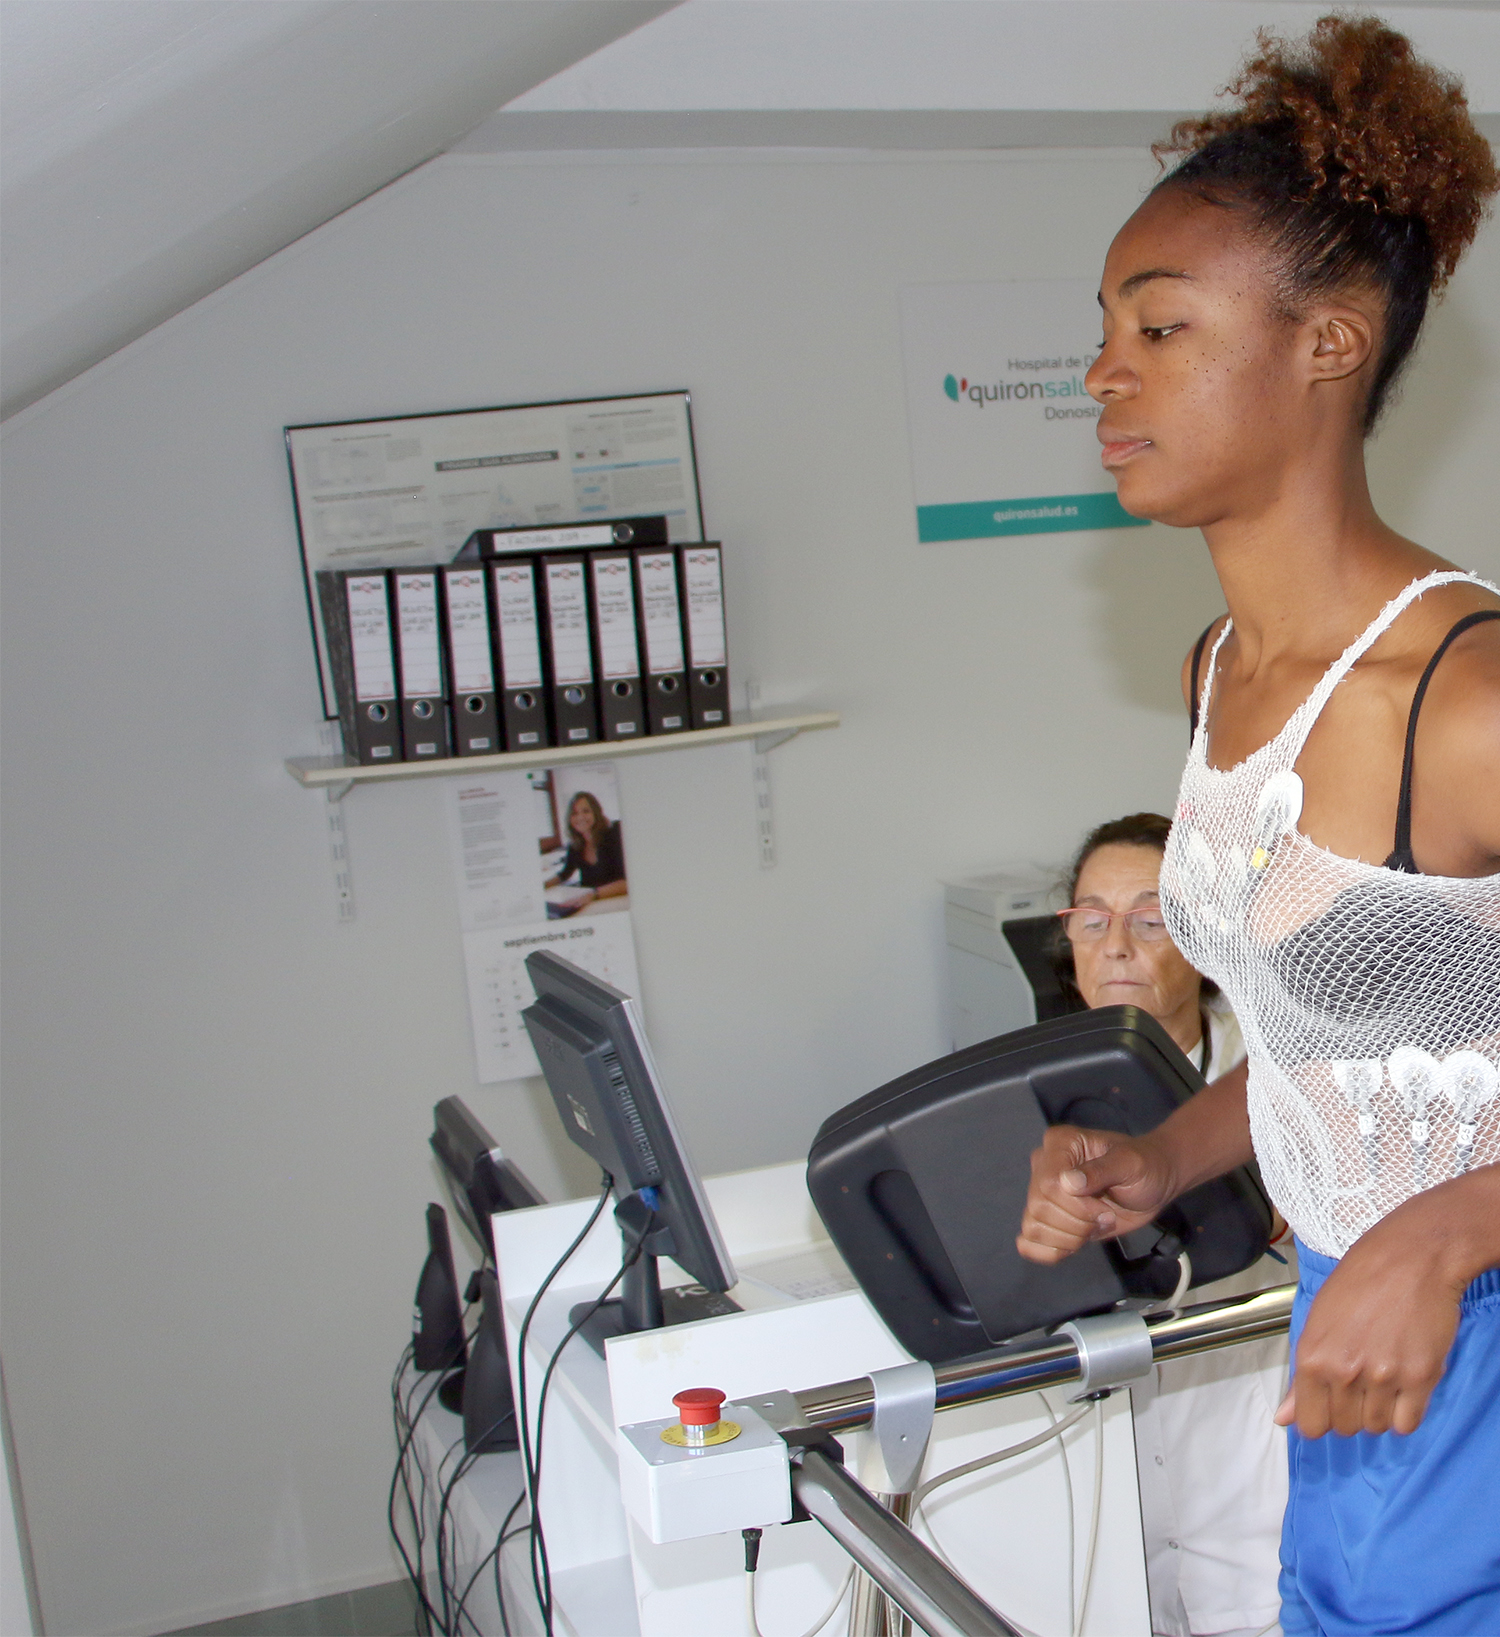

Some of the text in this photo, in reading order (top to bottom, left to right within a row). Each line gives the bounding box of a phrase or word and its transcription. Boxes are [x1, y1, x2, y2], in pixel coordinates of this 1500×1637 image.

[1008, 357, 1062, 372] Hospital
[1065, 357, 1081, 368] de
[968, 375, 1089, 408] quirónsalu
[1045, 406, 1102, 420] Donosti
[993, 505, 1078, 522] quironsalud.es
[503, 926, 595, 948] septiembre 2019
